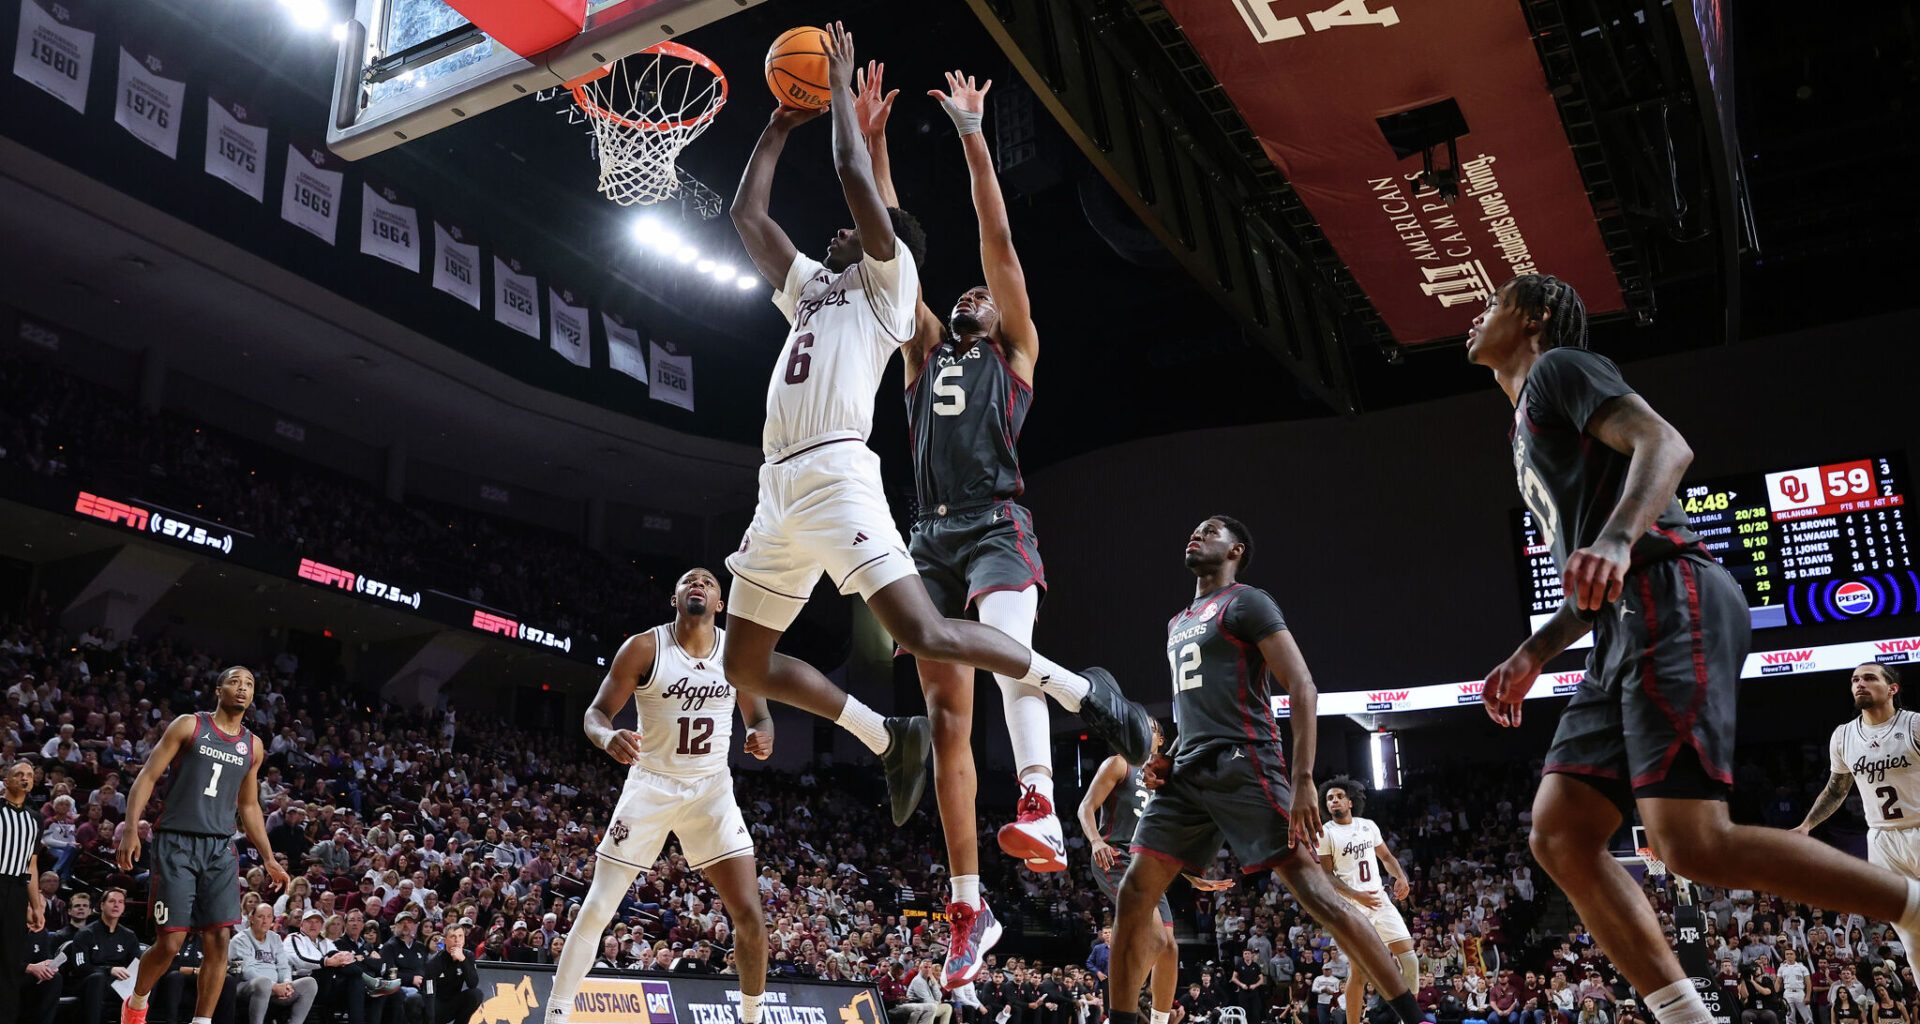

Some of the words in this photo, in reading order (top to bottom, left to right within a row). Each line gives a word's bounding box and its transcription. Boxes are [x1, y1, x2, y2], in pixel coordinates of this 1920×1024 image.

[32, 38, 78, 80] 1980
[126, 88, 169, 128] 1976
[219, 137, 256, 174] 1975
[1460, 153, 1498, 197] living.
[294, 184, 330, 218] 1969
[1478, 191, 1510, 221] love
[1367, 176, 1440, 260] AMERICAN
[372, 219, 410, 248] 1964
[1487, 216, 1532, 263] students
[445, 256, 472, 285] 1951
[504, 288, 533, 316] 1923
[784, 332, 814, 385] 6
[657, 368, 687, 391] 1920
[933, 366, 966, 416] 5
[1880, 464, 1890, 474] 3
[1686, 486, 1708, 498] 2ND
[1828, 468, 1870, 496] 59
[1884, 485, 1892, 496] 2
[1874, 498, 1886, 506] AST
[1890, 496, 1899, 504] PF
[75, 491, 149, 530] ESPN
[162, 519, 207, 544] 97.5
[1524, 516, 1530, 527] 3
[1702, 514, 1722, 522] GOALS
[1735, 507, 1766, 520] 20/38
[1776, 508, 1818, 520] OKLAHOMA
[1782, 524, 1788, 532] 1
[1791, 518, 1836, 532] X.BROWN
[1846, 516, 1852, 524] 4
[1862, 514, 1868, 522] 1
[1878, 512, 1885, 520] 2
[1894, 510, 1900, 518] 2
[1699, 526, 1732, 537] POINTERS
[1738, 521, 1768, 534] 10/20
[1784, 536, 1790, 544] 5
[1793, 530, 1840, 543] M.WAGUE
[1848, 528, 1854, 536] 0
[1864, 526, 1871, 534] 2
[1880, 524, 1888, 532] 0
[1896, 522, 1903, 530] 2
[1527, 536, 1534, 546] 1
[1742, 536, 1768, 548] 9/10
[1781, 548, 1792, 556] 12
[1795, 542, 1830, 556] J.JONES
[1850, 540, 1856, 548] 3
[1866, 538, 1874, 546] 0
[1884, 536, 1890, 544] 1
[1900, 534, 1906, 542] 1
[1530, 558, 1536, 566] 0
[1752, 551, 1766, 562] 10
[1783, 560, 1794, 568] 13
[1796, 554, 1834, 566] T.DAVIS
[1852, 551, 1859, 560] 9
[1869, 549, 1876, 558] 5
[1886, 547, 1892, 556] 1
[1902, 545, 1908, 554] 1
[298, 558, 356, 591] ESPN
[366, 580, 400, 602] 97.5
[1532, 570, 1538, 578] 2
[1754, 566, 1768, 576] 13
[1784, 571, 1796, 580] 35
[1799, 566, 1832, 578] D.REID
[1852, 562, 1864, 572] 16
[1872, 560, 1878, 569] 5
[1886, 559, 1894, 568] 0
[1904, 558, 1910, 566] 1
[1534, 580, 1540, 588] 3
[1756, 580, 1770, 591] 25
[1532, 602, 1542, 610] 12
[1762, 596, 1770, 606] 7
[1838, 594, 1870, 602] PEPSI
[472, 610, 518, 638] ESPN
[526, 627, 554, 646] 97.5
[1761, 650, 1814, 664] WTAW
[1794, 661, 1816, 670] 1620
[1877, 654, 1908, 662] NewsTalk
[1168, 641, 1202, 696] 12
[1553, 673, 1584, 684] WTA
[662, 677, 730, 711] Aggies
[1368, 690, 1410, 702] WTAW
[1458, 682, 1484, 694] WTA
[676, 716, 714, 755] 12
[199, 745, 244, 766] SOONERS
[204, 762, 223, 798] 1
[1852, 754, 1912, 784] Aggies
[1876, 786, 1904, 820] 2
[1358, 860, 1371, 882] 0
[574, 992, 640, 1014] MUSTANG
[646, 993, 670, 1014] CAT
[688, 1003, 735, 1024] TEXAS
[763, 1005, 826, 1024] ATHLETICS
